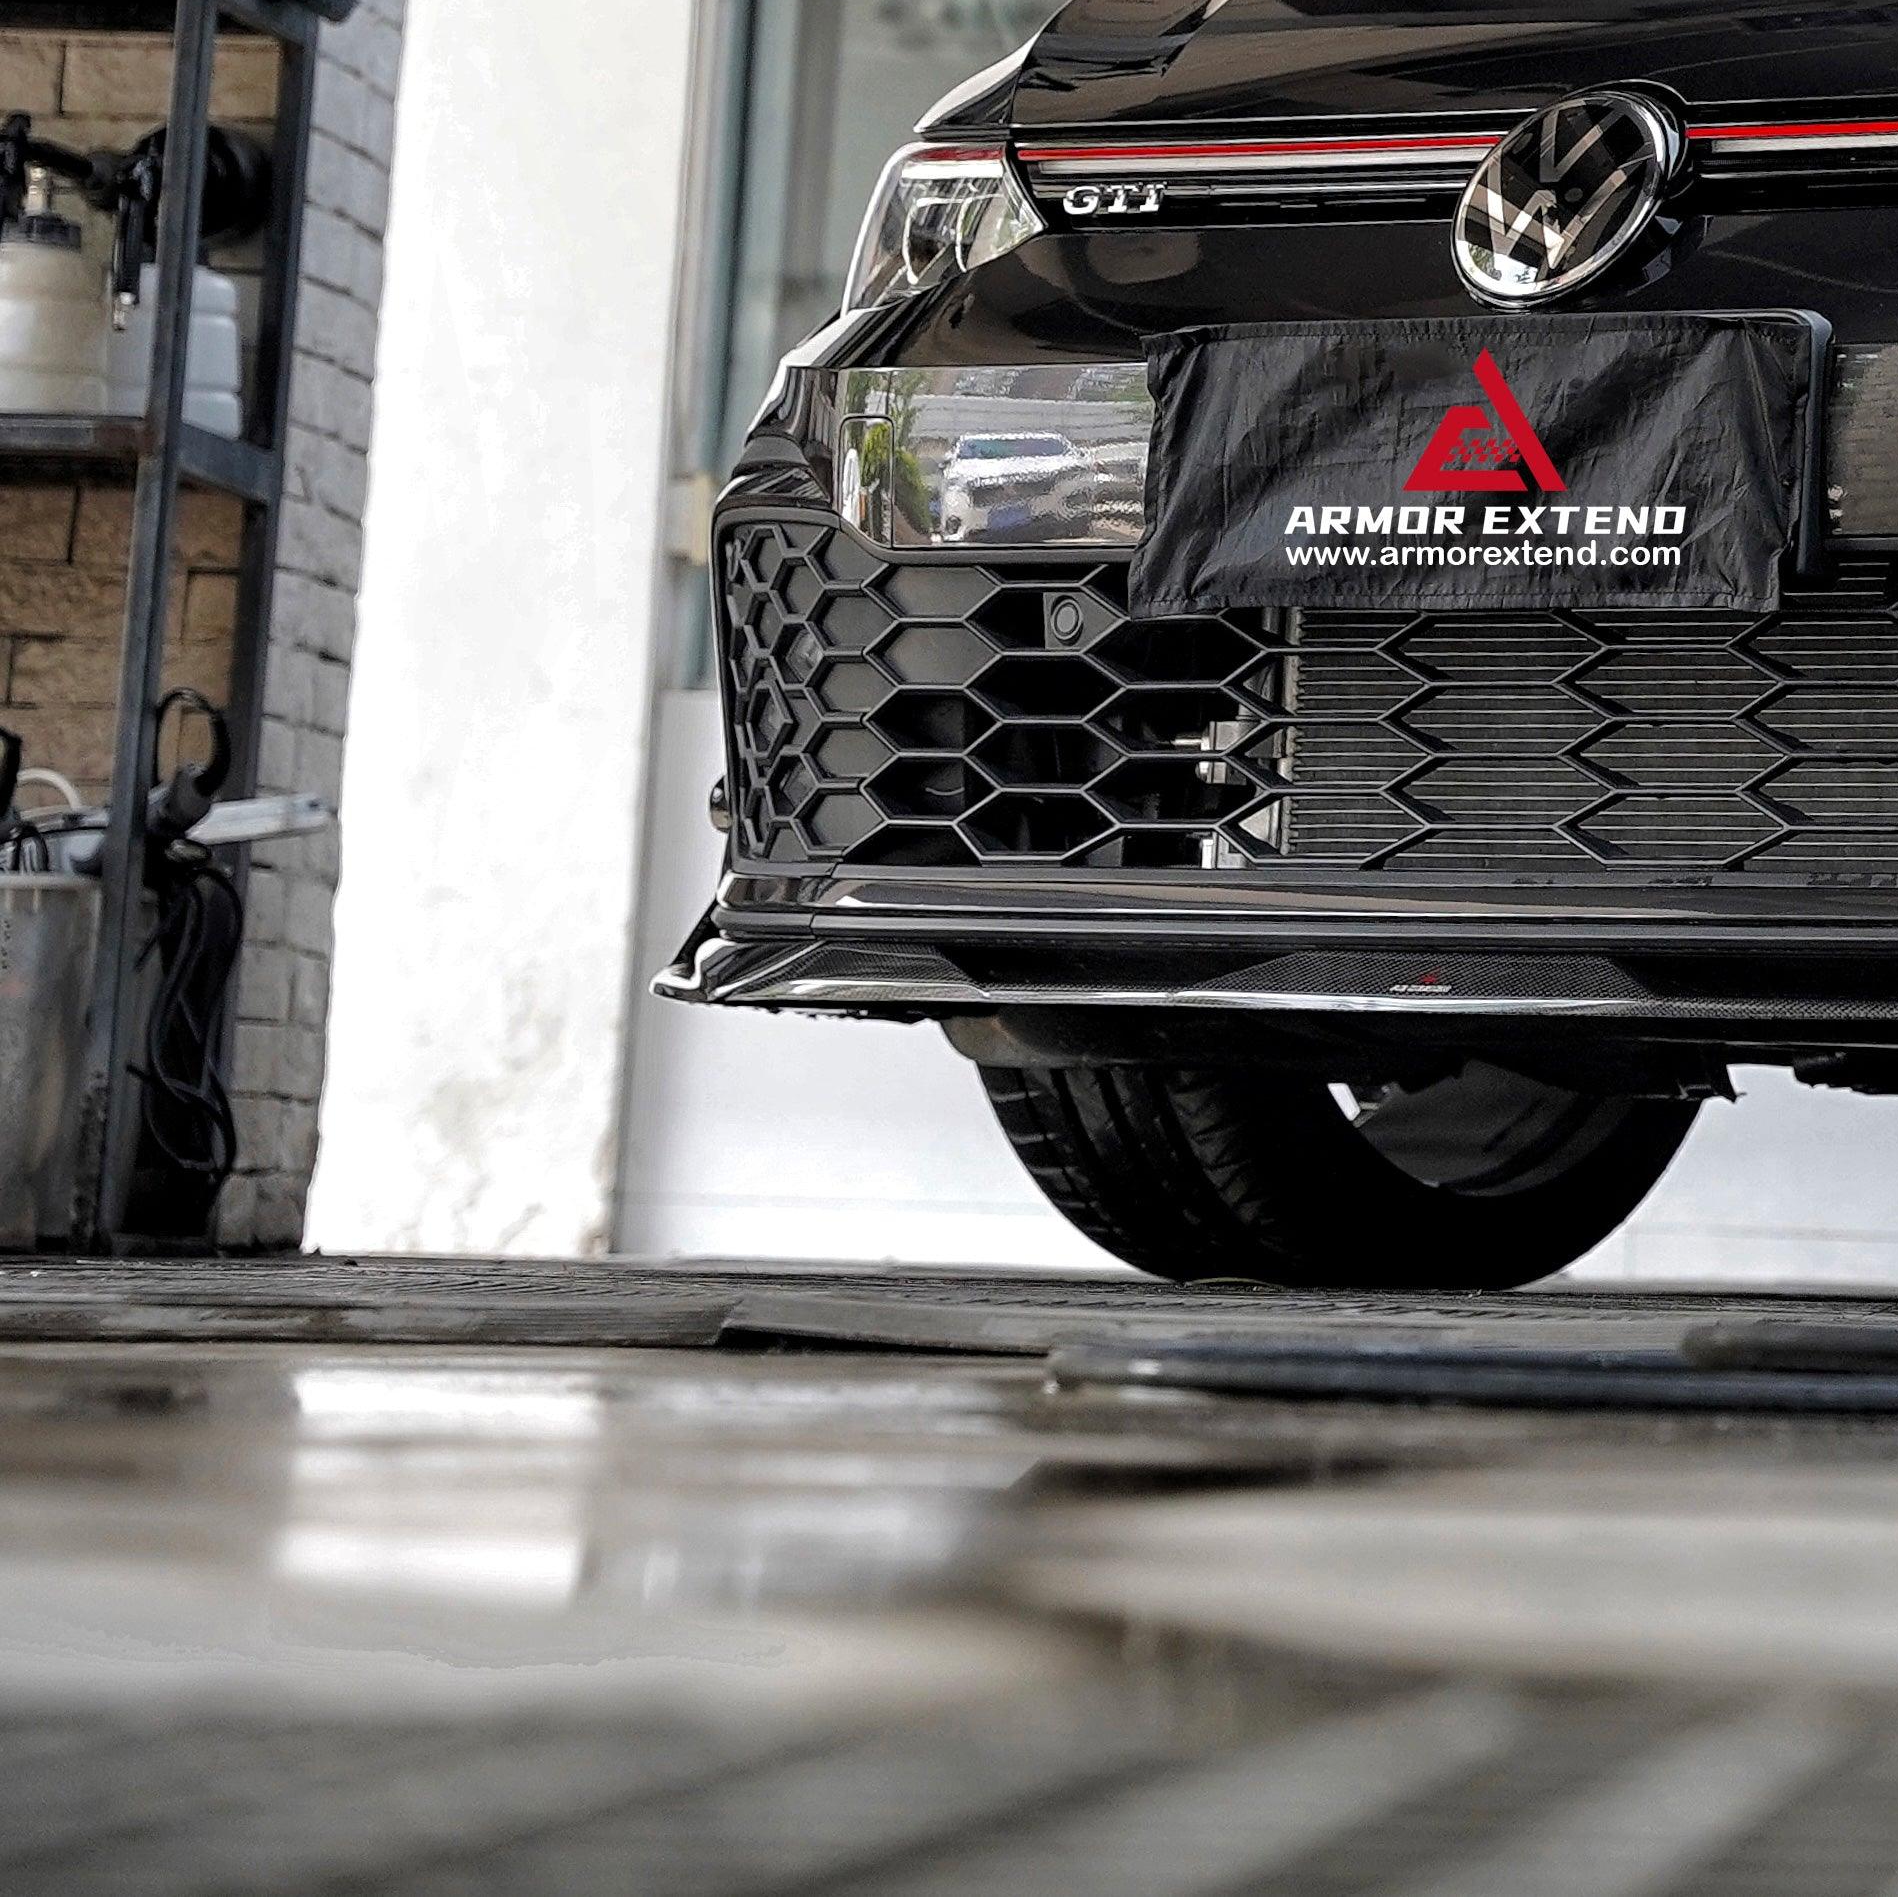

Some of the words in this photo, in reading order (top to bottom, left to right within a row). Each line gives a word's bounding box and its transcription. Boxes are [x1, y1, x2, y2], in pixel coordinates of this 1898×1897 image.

[1062, 182, 1167, 215] GTI
[1284, 505, 1466, 535] ARMOR
[1482, 505, 1687, 535] EXTEND
[1285, 539, 1682, 567] www.armorextend.com
